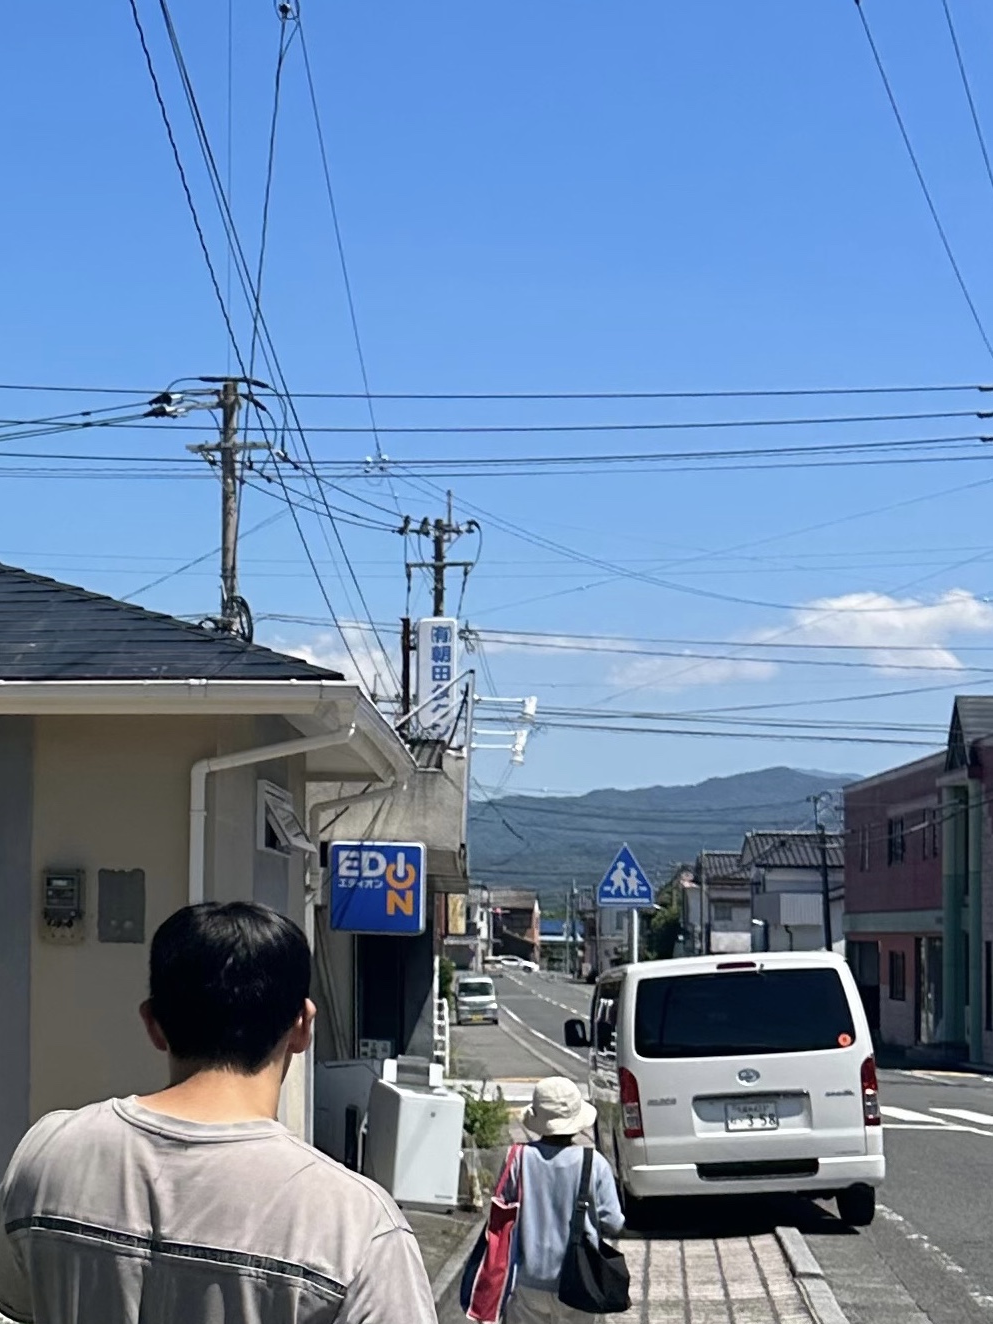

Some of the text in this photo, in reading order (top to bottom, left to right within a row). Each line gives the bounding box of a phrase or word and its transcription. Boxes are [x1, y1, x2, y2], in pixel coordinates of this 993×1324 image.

[338, 850, 416, 916] EDION
[338, 878, 384, 889] エディオン
